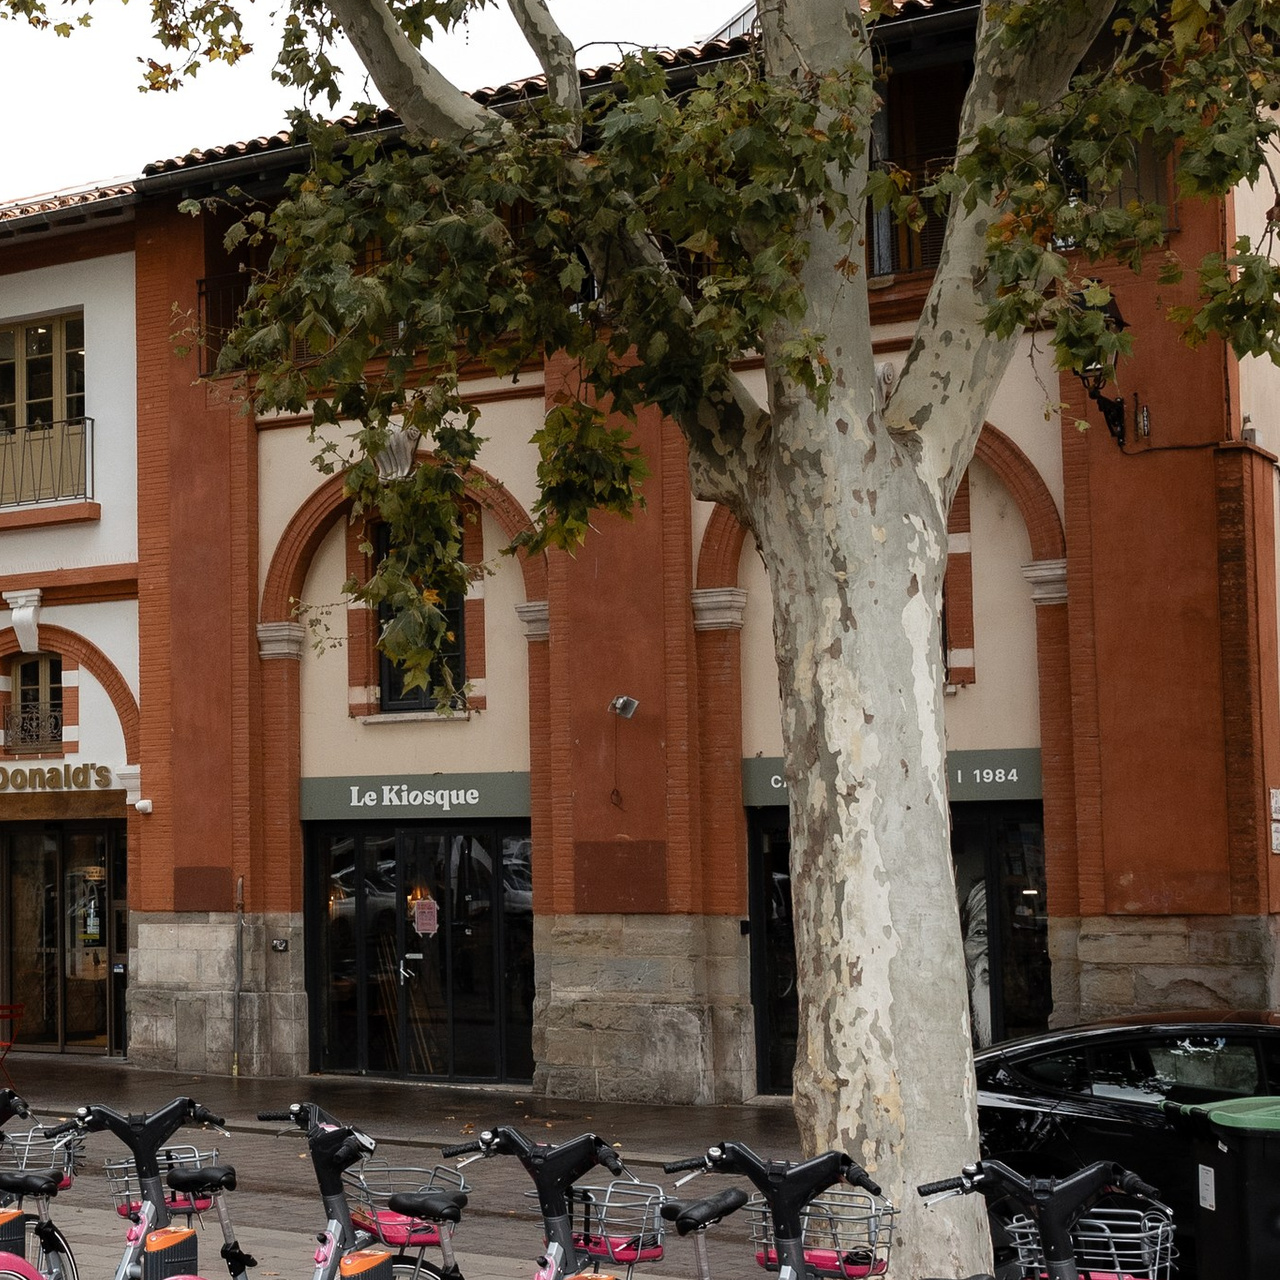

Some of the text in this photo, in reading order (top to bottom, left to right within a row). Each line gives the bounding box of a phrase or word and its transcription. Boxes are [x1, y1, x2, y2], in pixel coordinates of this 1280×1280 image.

[973, 768, 1018, 783] 1984
[350, 784, 480, 811] Le Kiosque
